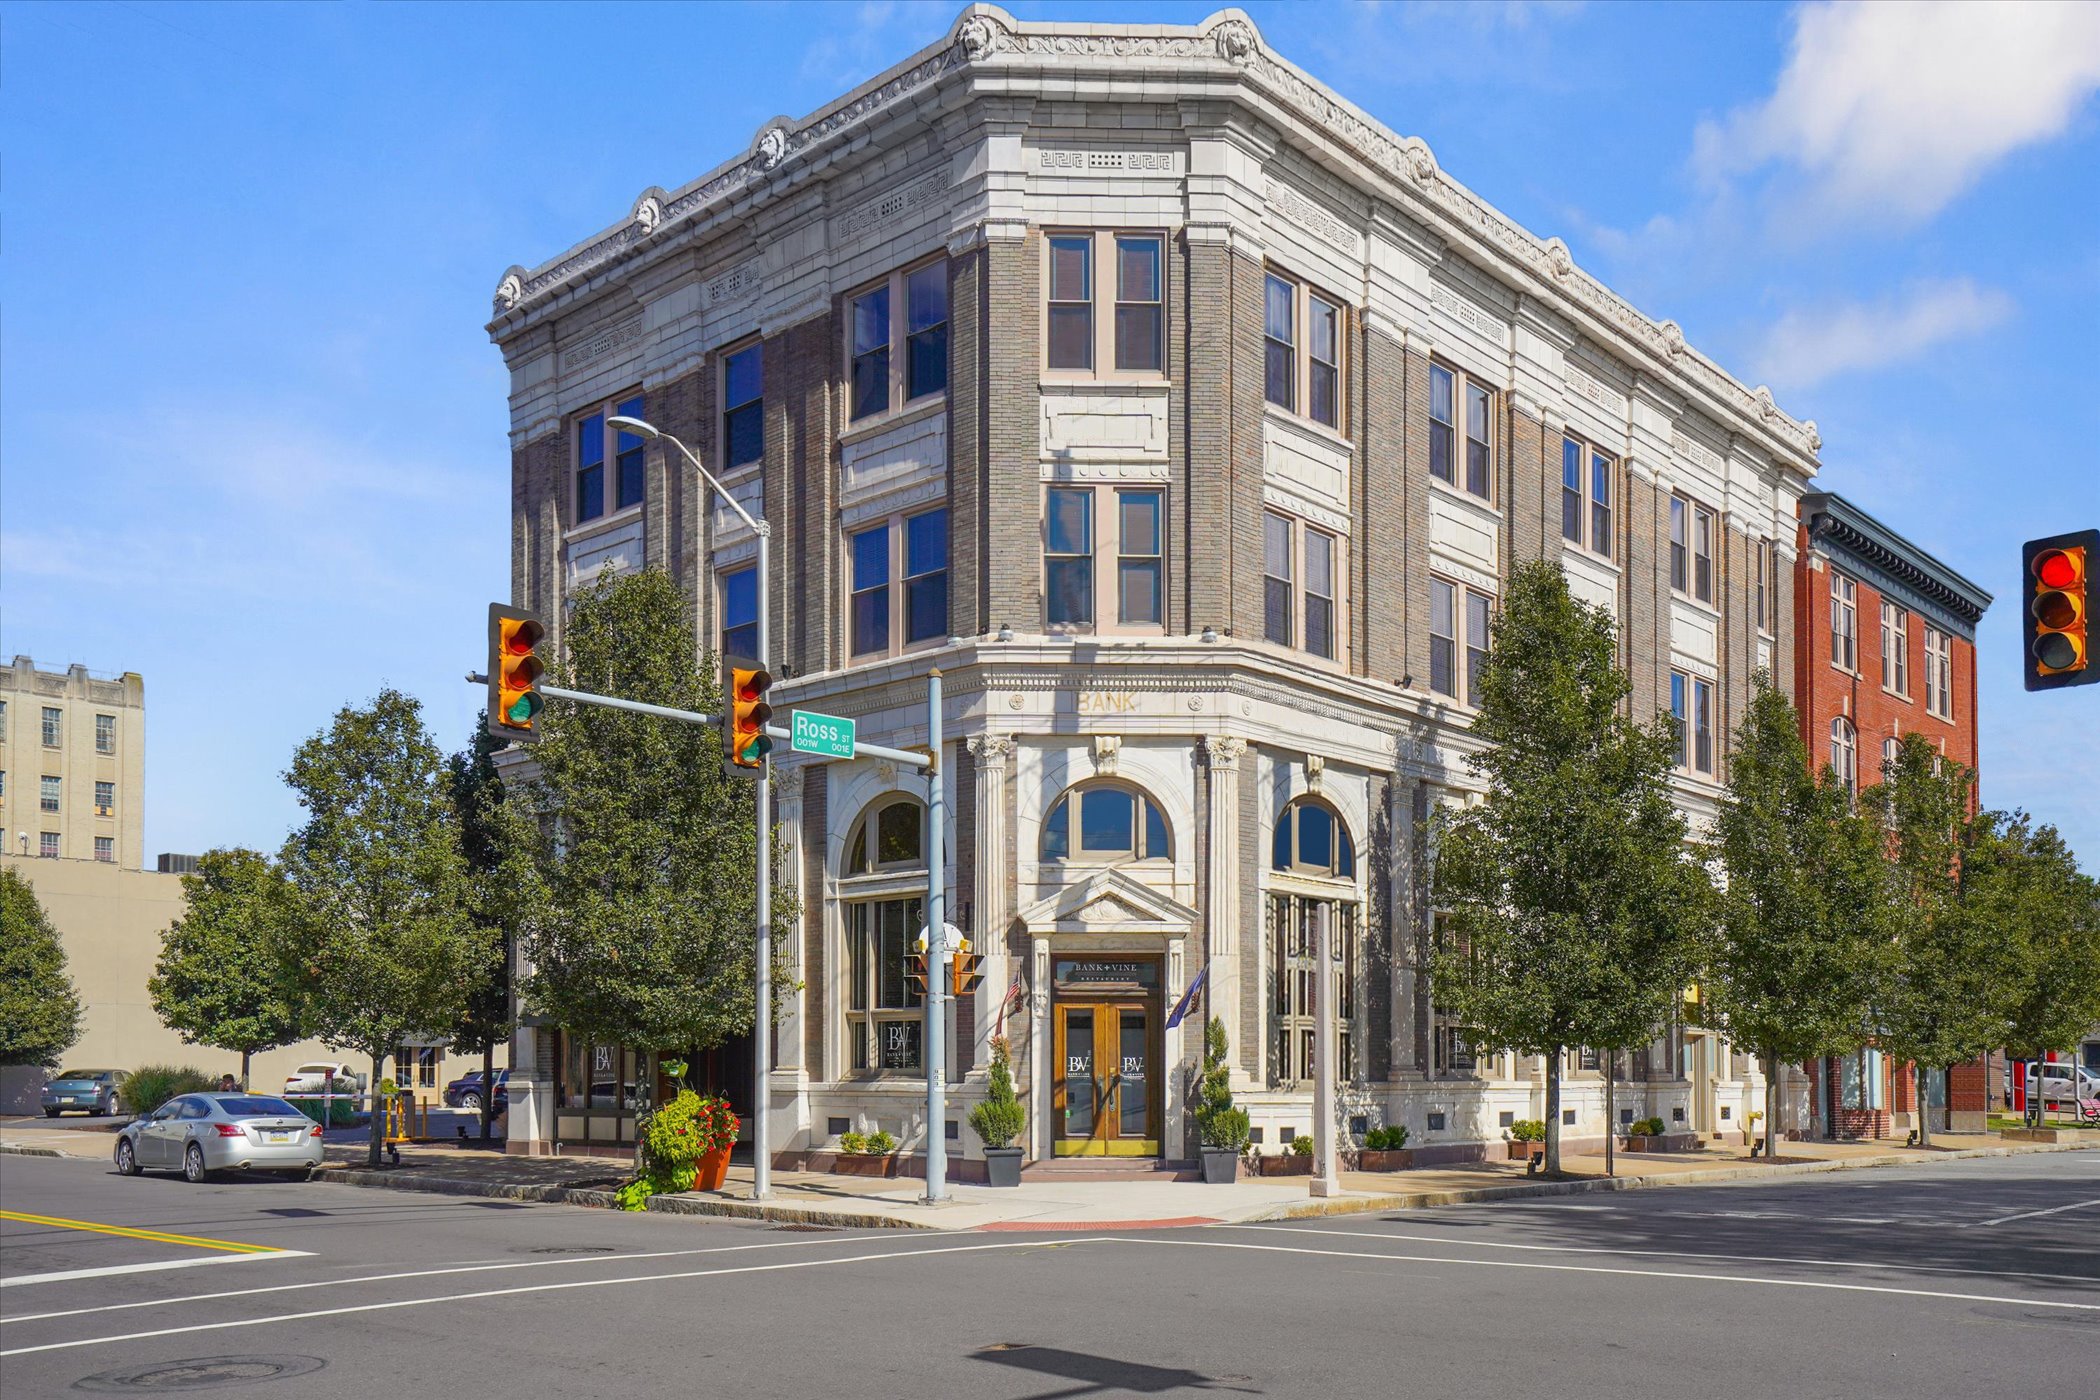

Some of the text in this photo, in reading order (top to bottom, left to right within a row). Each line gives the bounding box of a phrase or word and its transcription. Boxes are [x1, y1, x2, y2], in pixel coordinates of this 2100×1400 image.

[1076, 691, 1136, 712] BANK
[797, 737, 850, 753] 001W 001E
[841, 734, 850, 743] ST
[888, 1026, 910, 1050] BV
[595, 1046, 614, 1070] BV
[1068, 1056, 1090, 1072] BV
[1123, 1057, 1144, 1072] BV
